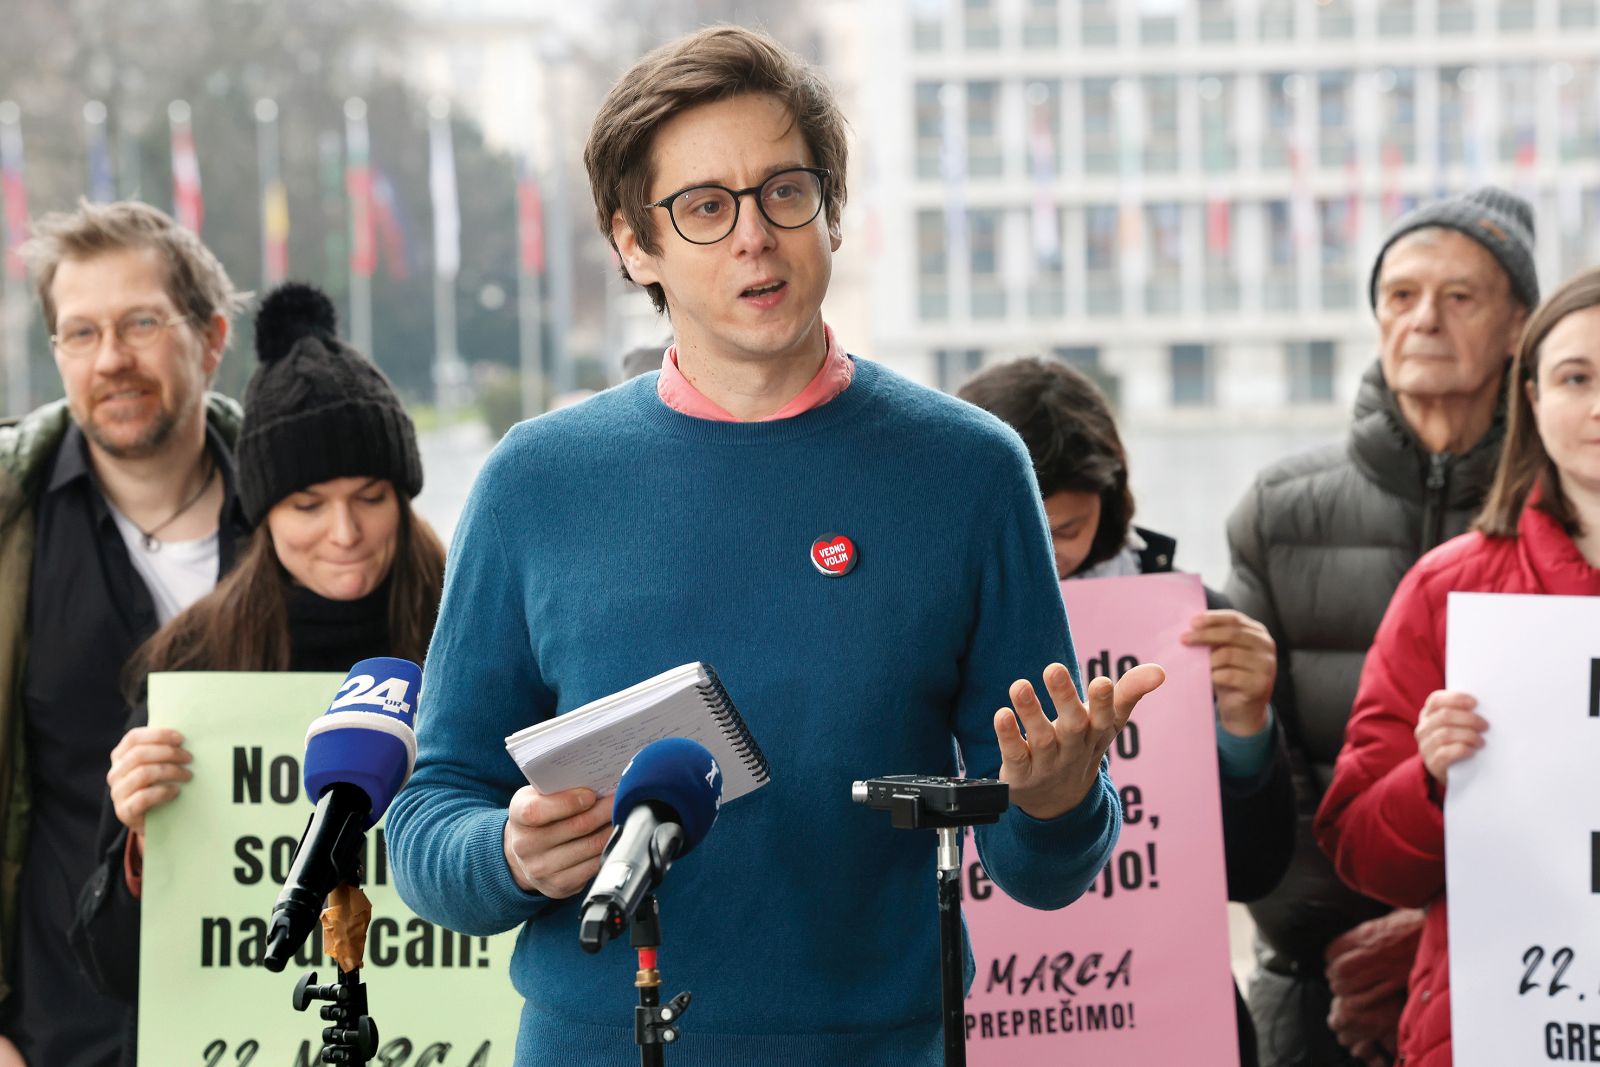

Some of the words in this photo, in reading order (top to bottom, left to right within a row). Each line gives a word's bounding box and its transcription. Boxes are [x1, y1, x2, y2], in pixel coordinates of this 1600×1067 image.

[819, 543, 846, 558] VEDNO
[823, 552, 848, 567] VOLIM
[330, 674, 411, 714] 24
[986, 949, 1133, 996] MARCA
[965, 1000, 1136, 1041] PREPREČIMO!
